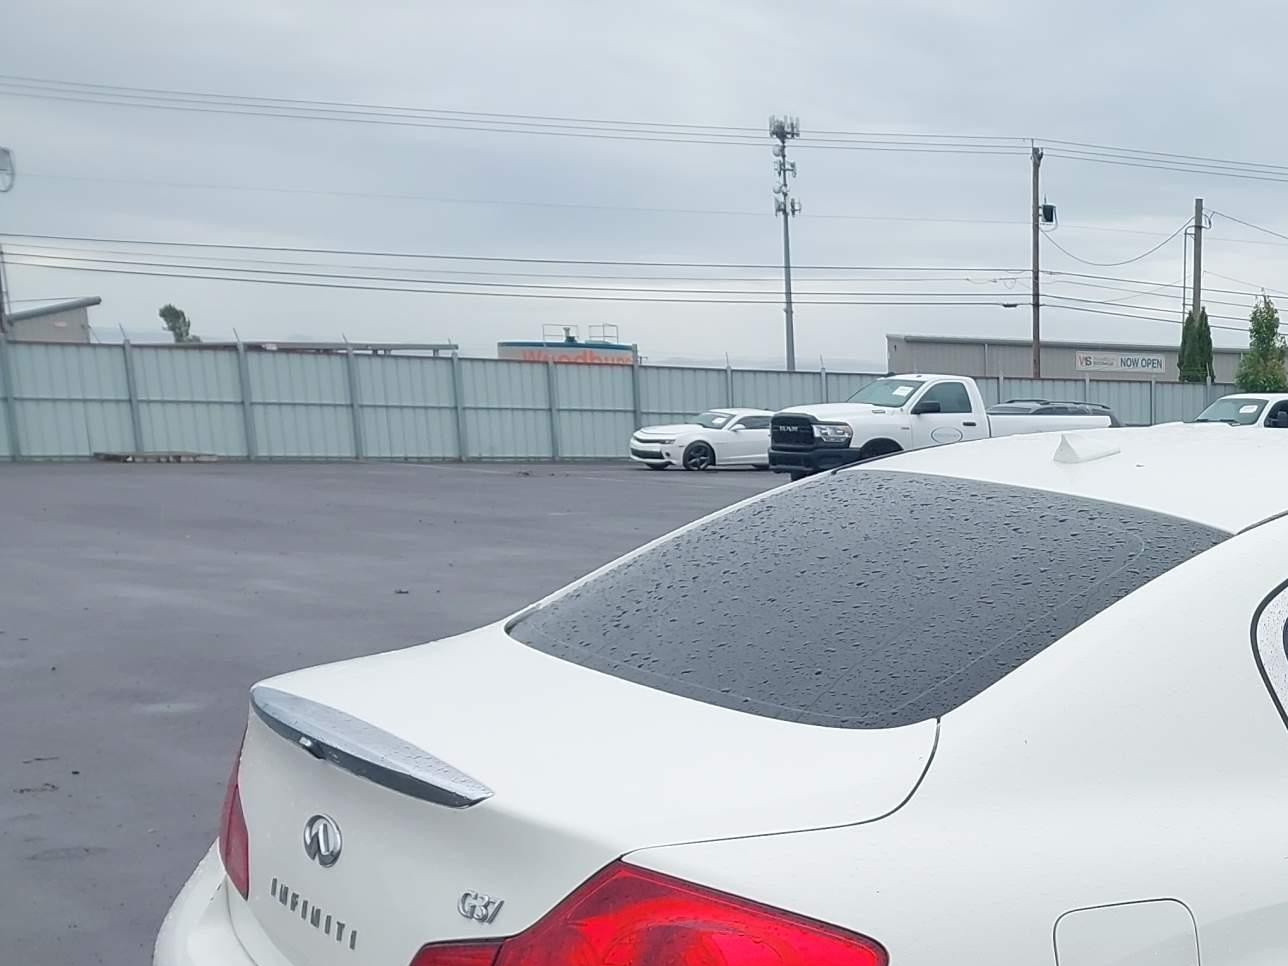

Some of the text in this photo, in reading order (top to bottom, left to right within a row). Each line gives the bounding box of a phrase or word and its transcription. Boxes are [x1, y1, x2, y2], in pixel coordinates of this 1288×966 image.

[1120, 357, 1139, 368] NOW
[1140, 358, 1163, 369] OPEN
[270, 877, 358, 951] INFINITI
[457, 890, 505, 925] G37
